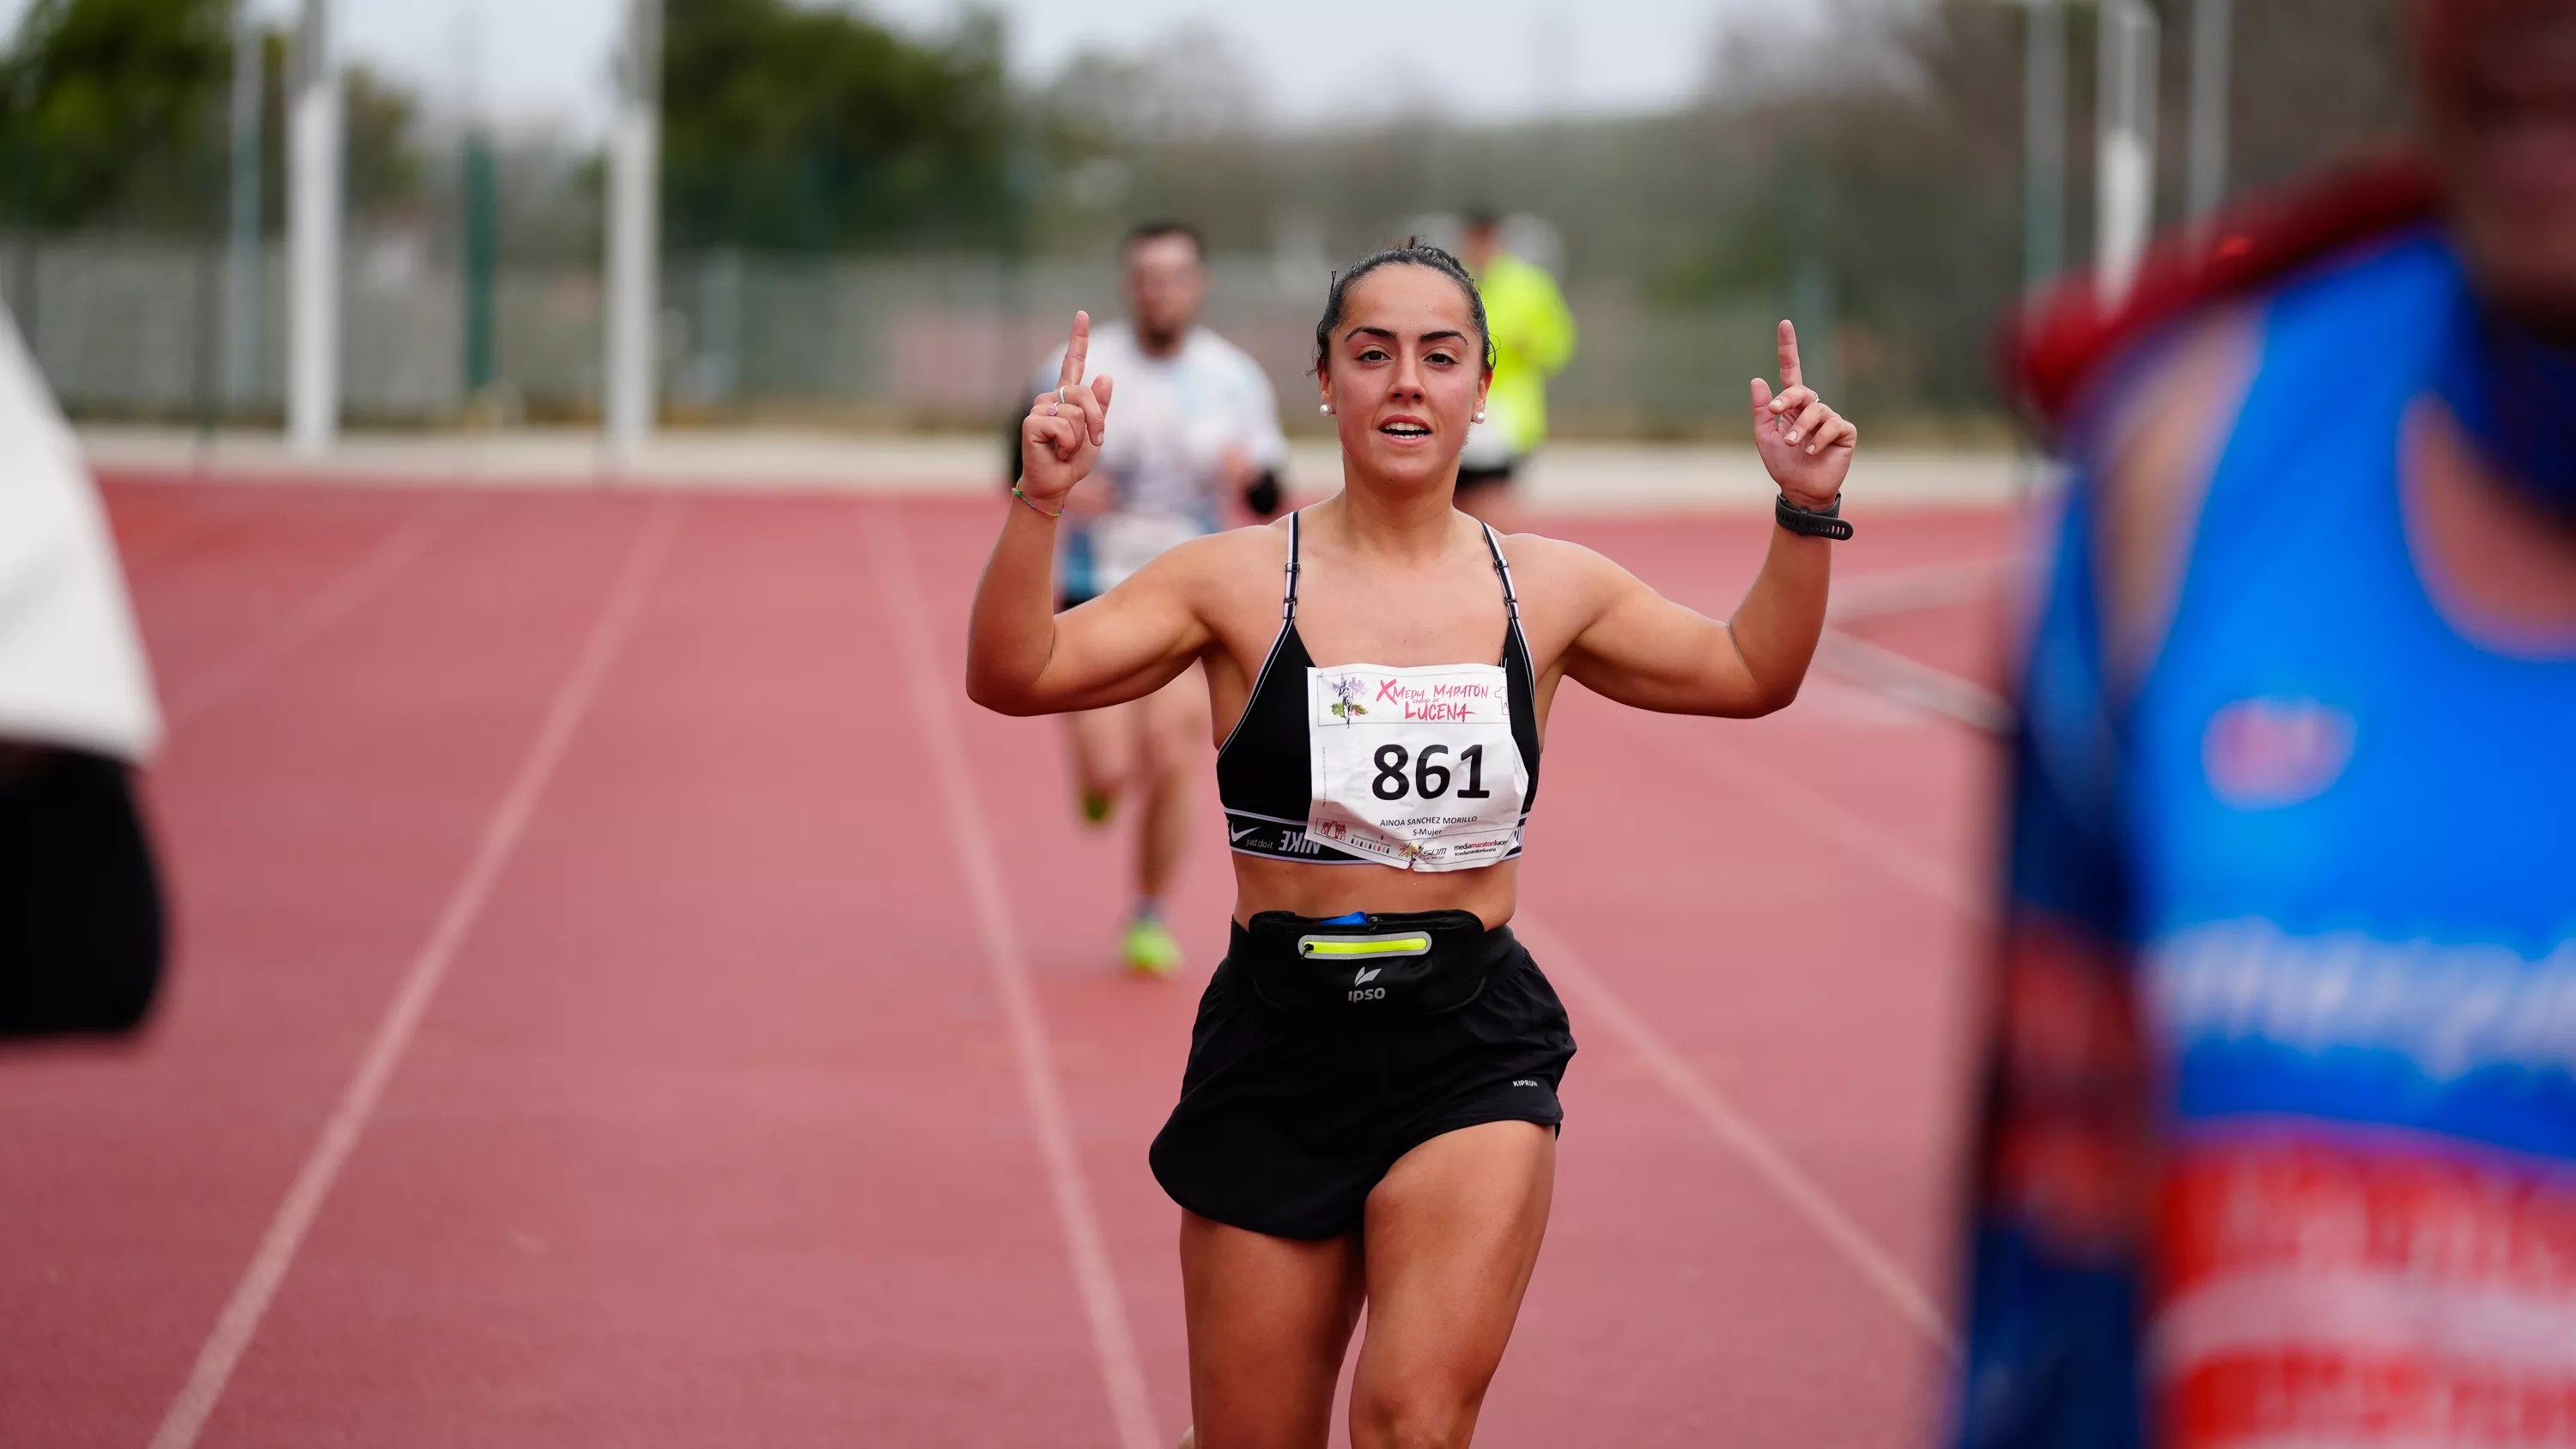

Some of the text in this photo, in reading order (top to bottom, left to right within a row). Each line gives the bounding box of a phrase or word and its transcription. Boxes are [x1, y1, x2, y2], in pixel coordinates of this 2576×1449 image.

[1433, 683, 1489, 700] MARATÓN
[1405, 700, 1477, 723] LUCENA
[1371, 743, 1490, 800] 861
[1406, 816, 1441, 826] SANCHEZ
[1443, 815, 1478, 824] MORILLO
[1413, 828, 1443, 837] S-Mujer
[1245, 837, 1257, 846] just
[1257, 839, 1267, 848] do
